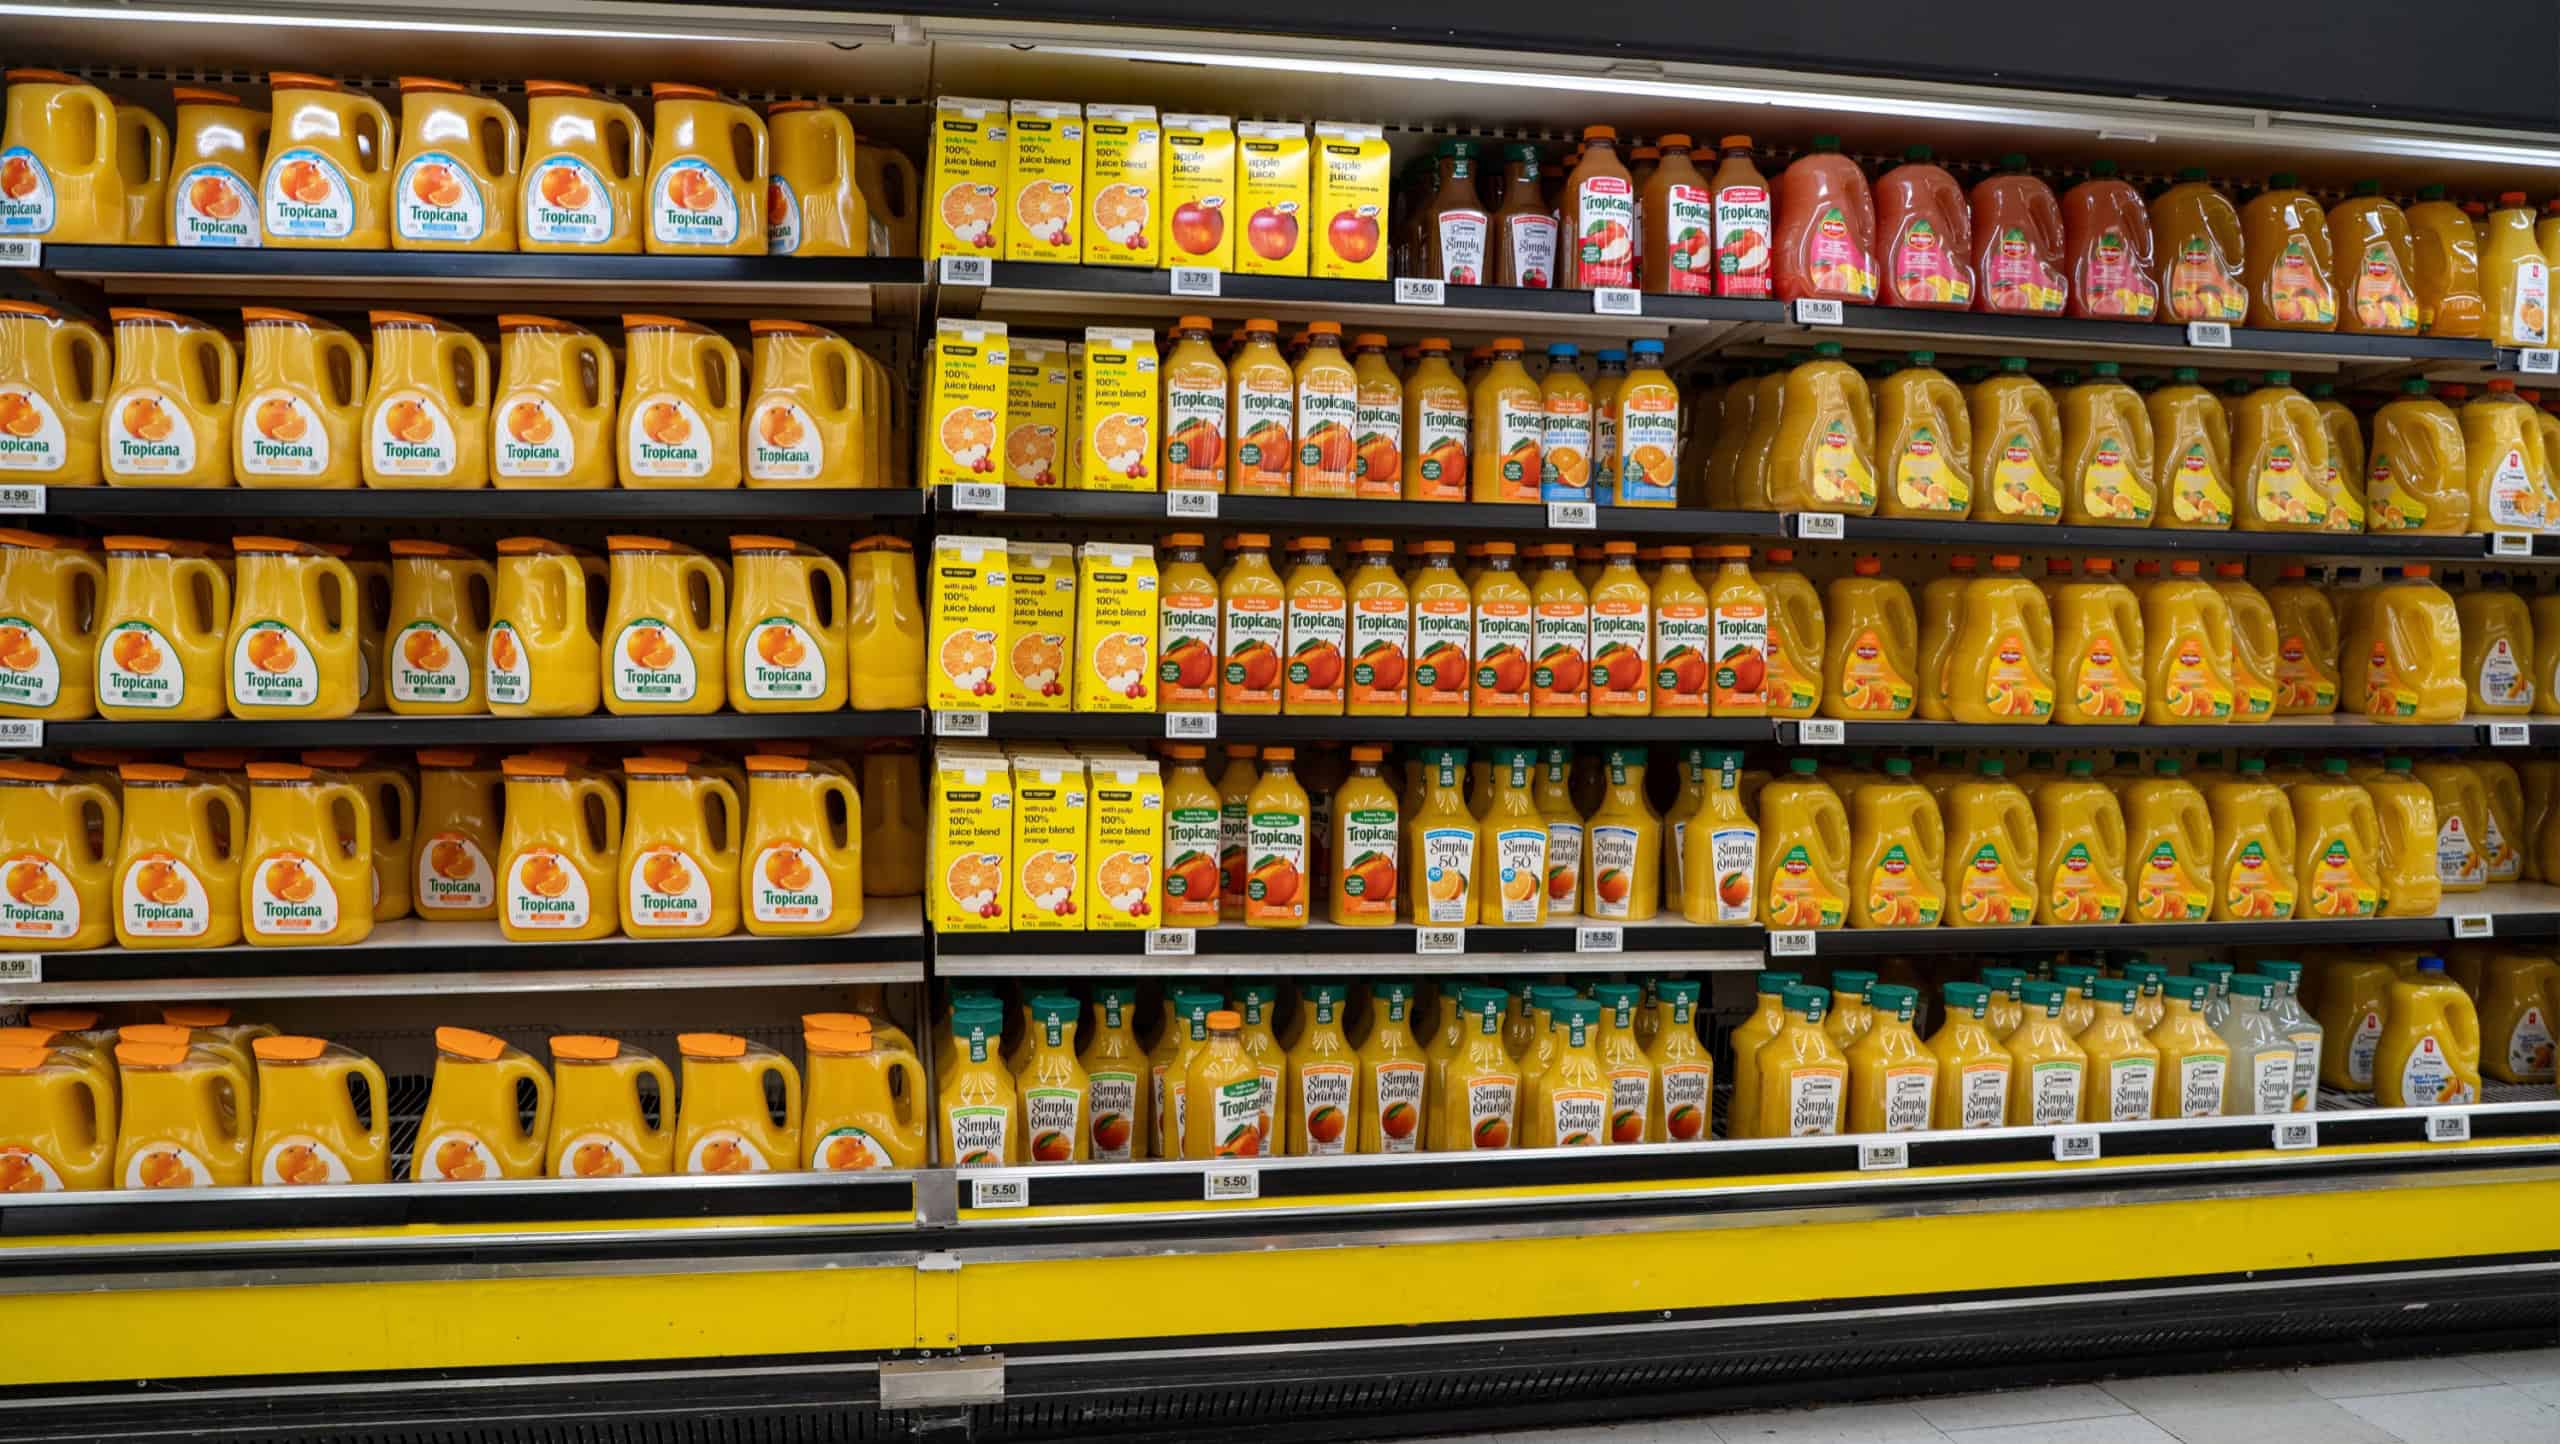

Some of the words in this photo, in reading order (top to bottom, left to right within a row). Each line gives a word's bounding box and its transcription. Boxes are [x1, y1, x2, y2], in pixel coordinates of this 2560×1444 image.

[945, 146, 971, 155] 100%
[1019, 145, 1045, 154] 100%
[944, 157, 967, 168] juice
[969, 157, 997, 168] blend
[1019, 155, 1042, 166] juice
[1044, 155, 1072, 166] blend
[1172, 152, 1205, 165] apple
[1248, 157, 1280, 170] apple
[1329, 160, 1361, 173] apple
[1172, 163, 1201, 174] juice
[1248, 168, 1275, 181] juice
[1329, 171, 1357, 182] juice
[277, 203, 337, 220] Tropicana
[1582, 194, 1633, 214] Tropicana
[411, 207, 468, 224] Tropicana
[538, 207, 596, 225] Tropicana
[666, 210, 723, 227] Tropicana
[188, 218, 248, 236] Tropicana
[954, 261, 978, 272] 4.99
[1184, 273, 1207, 283] 3.79
[1412, 283, 1434, 293] 5.50
[945, 369, 969, 379] 100%
[944, 381, 966, 391] juice
[968, 381, 996, 392] blend
[1096, 378, 1120, 387] 100%
[1095, 389, 1117, 399] juice
[1119, 389, 1147, 398] blend
[1170, 392, 1223, 409] Tropicana
[1242, 394, 1291, 411] Tropicana
[1302, 394, 1355, 413] Tropicana
[1626, 413, 1676, 432] Tropicana
[121, 441, 180, 458] Tropicana
[254, 441, 312, 458] Tropicana
[384, 442, 440, 459] Tropicana
[506, 444, 559, 461] Tropicana
[640, 444, 697, 461] Tropicana
[757, 447, 809, 464] Tropicana
[3, 490, 28, 501] 8.99
[968, 489, 991, 499] 4.99
[1182, 495, 1204, 506] 5.49
[1562, 507, 1583, 517] 5.49
[944, 592, 969, 601] 100%
[1014, 597, 1039, 606] 100%
[1096, 597, 1120, 606] 100%
[943, 603, 966, 614] juice
[968, 604, 995, 613] blend
[1014, 608, 1035, 618] juice
[1037, 608, 1064, 617] blend
[1096, 607, 1118, 618] juice
[1120, 607, 1147, 617] blend
[1164, 611, 1216, 628] Tropicana
[1229, 612, 1282, 629] Tropicana
[1291, 612, 1344, 629] Tropicana
[1356, 614, 1408, 631] Tropicana
[1419, 615, 1469, 634] Tropicana
[1479, 617, 1530, 635] Tropicana
[1535, 617, 1587, 635] Tropicana
[1592, 615, 1645, 634] Tropicana
[1717, 618, 1766, 637] Tropicana
[1658, 620, 1708, 637] Tropicana
[110, 673, 168, 691] Tropicana
[244, 672, 302, 690] Tropicana
[403, 671, 456, 688] Tropicana
[624, 669, 681, 686] Tropicana
[755, 667, 812, 684] Tropicana
[951, 714, 974, 725] 5.29
[1181, 717, 1203, 727] 5.49
[1, 724, 26, 735] 8.99
[949, 817, 974, 825] 100%
[1024, 815, 1049, 824] 100%
[1101, 815, 1125, 824] 100%
[949, 827, 972, 837] juice
[974, 827, 1001, 836] blend
[1024, 825, 1046, 835] juice
[1048, 825, 1075, 834] blend
[1100, 826, 1122, 836] juice
[1125, 826, 1150, 835] blend
[1168, 823, 1220, 842] Tropicana
[1249, 828, 1302, 848] Tropicana
[1430, 839, 1470, 857] Simply
[1504, 840, 1541, 857] Simply
[1718, 841, 1753, 858] Simply
[1438, 856, 1460, 868] 50
[1512, 857, 1532, 868] 50
[1717, 854, 1753, 871] Orange
[430, 879, 480, 895] Tropicana
[518, 897, 575, 913] Tropicana
[640, 894, 697, 911] Tropicana
[763, 891, 818, 906] Tropicana
[3, 905, 64, 922] Tropicana
[134, 904, 193, 921] Tropicana
[263, 902, 322, 919] Tropicana
[1160, 933, 1182, 944] 5.49
[1433, 933, 1454, 943] 5.50
[1786, 935, 1805, 944] 8.50
[0, 960, 25, 971] 8.99
[1308, 1075, 1347, 1091] Simply
[1382, 1072, 1419, 1088] Simply
[1667, 1072, 1705, 1089] Simply
[2259, 1079, 2290, 1095] Simply
[1307, 1088, 1347, 1104] Orange
[1381, 1086, 1418, 1102] Orange
[1474, 1086, 1511, 1102] Simply
[1666, 1086, 1705, 1103] Orange
[2115, 1088, 2150, 1103] Simply
[2185, 1082, 2220, 1098] Simply
[1796, 1098, 1834, 1114] Simply
[1891, 1098, 1927, 1113] Simply
[1967, 1094, 2001, 1110] Simply
[2038, 1091, 2074, 1106] Simply
[2184, 1095, 2219, 1112] Orange
[1032, 1099, 1073, 1116] Simply
[1472, 1100, 1511, 1116] Orange
[1560, 1100, 1599, 1117] Simply
[1965, 1107, 2001, 1122] Orange
[2036, 1104, 2074, 1120] Orange
[2114, 1101, 2150, 1117] Orange
[1031, 1113, 1073, 1129] Orange
[1559, 1114, 1600, 1131] Orange
[1794, 1111, 1834, 1128] Orange
[1889, 1110, 1927, 1126] Orange
[2440, 1118, 2459, 1128] 7.29
[957, 1118, 1000, 1135] Simply
[2287, 1125, 2306, 1136] 7.29
[957, 1132, 1001, 1149] Orange
[992, 1183, 1016, 1195] 5.50
[1223, 1175, 1247, 1187] 5.50
